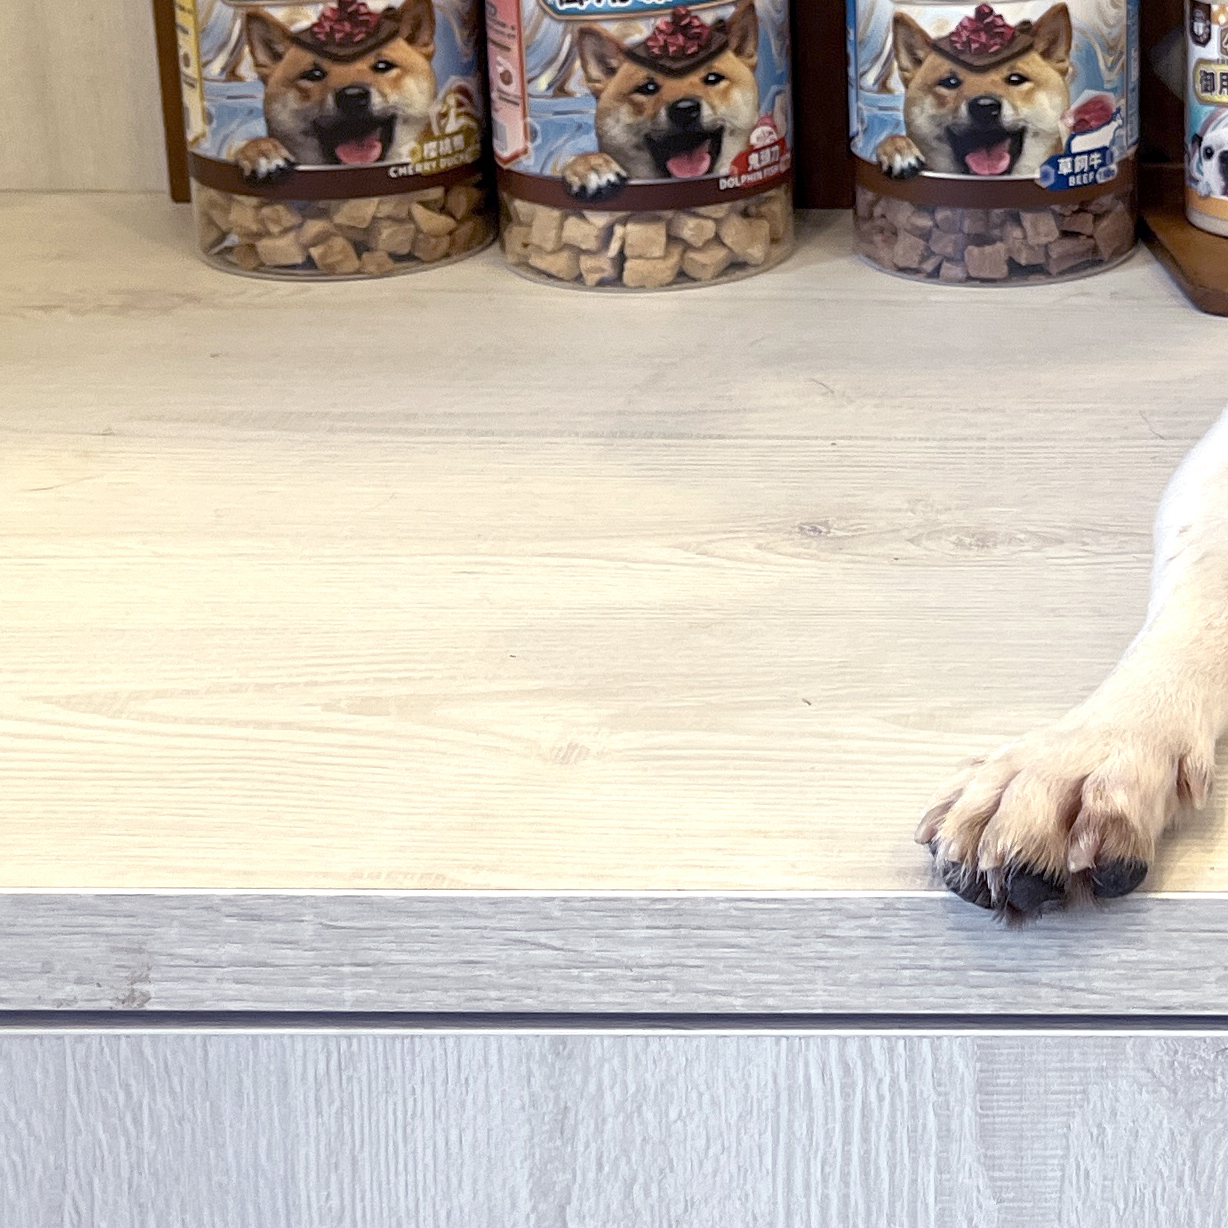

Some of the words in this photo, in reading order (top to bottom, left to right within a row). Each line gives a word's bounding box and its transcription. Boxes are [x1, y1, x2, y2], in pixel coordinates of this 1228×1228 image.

[388, 160, 437, 179] CHERRY
[1068, 171, 1095, 187] BEEF
[719, 170, 763, 191] DOLPHIN
